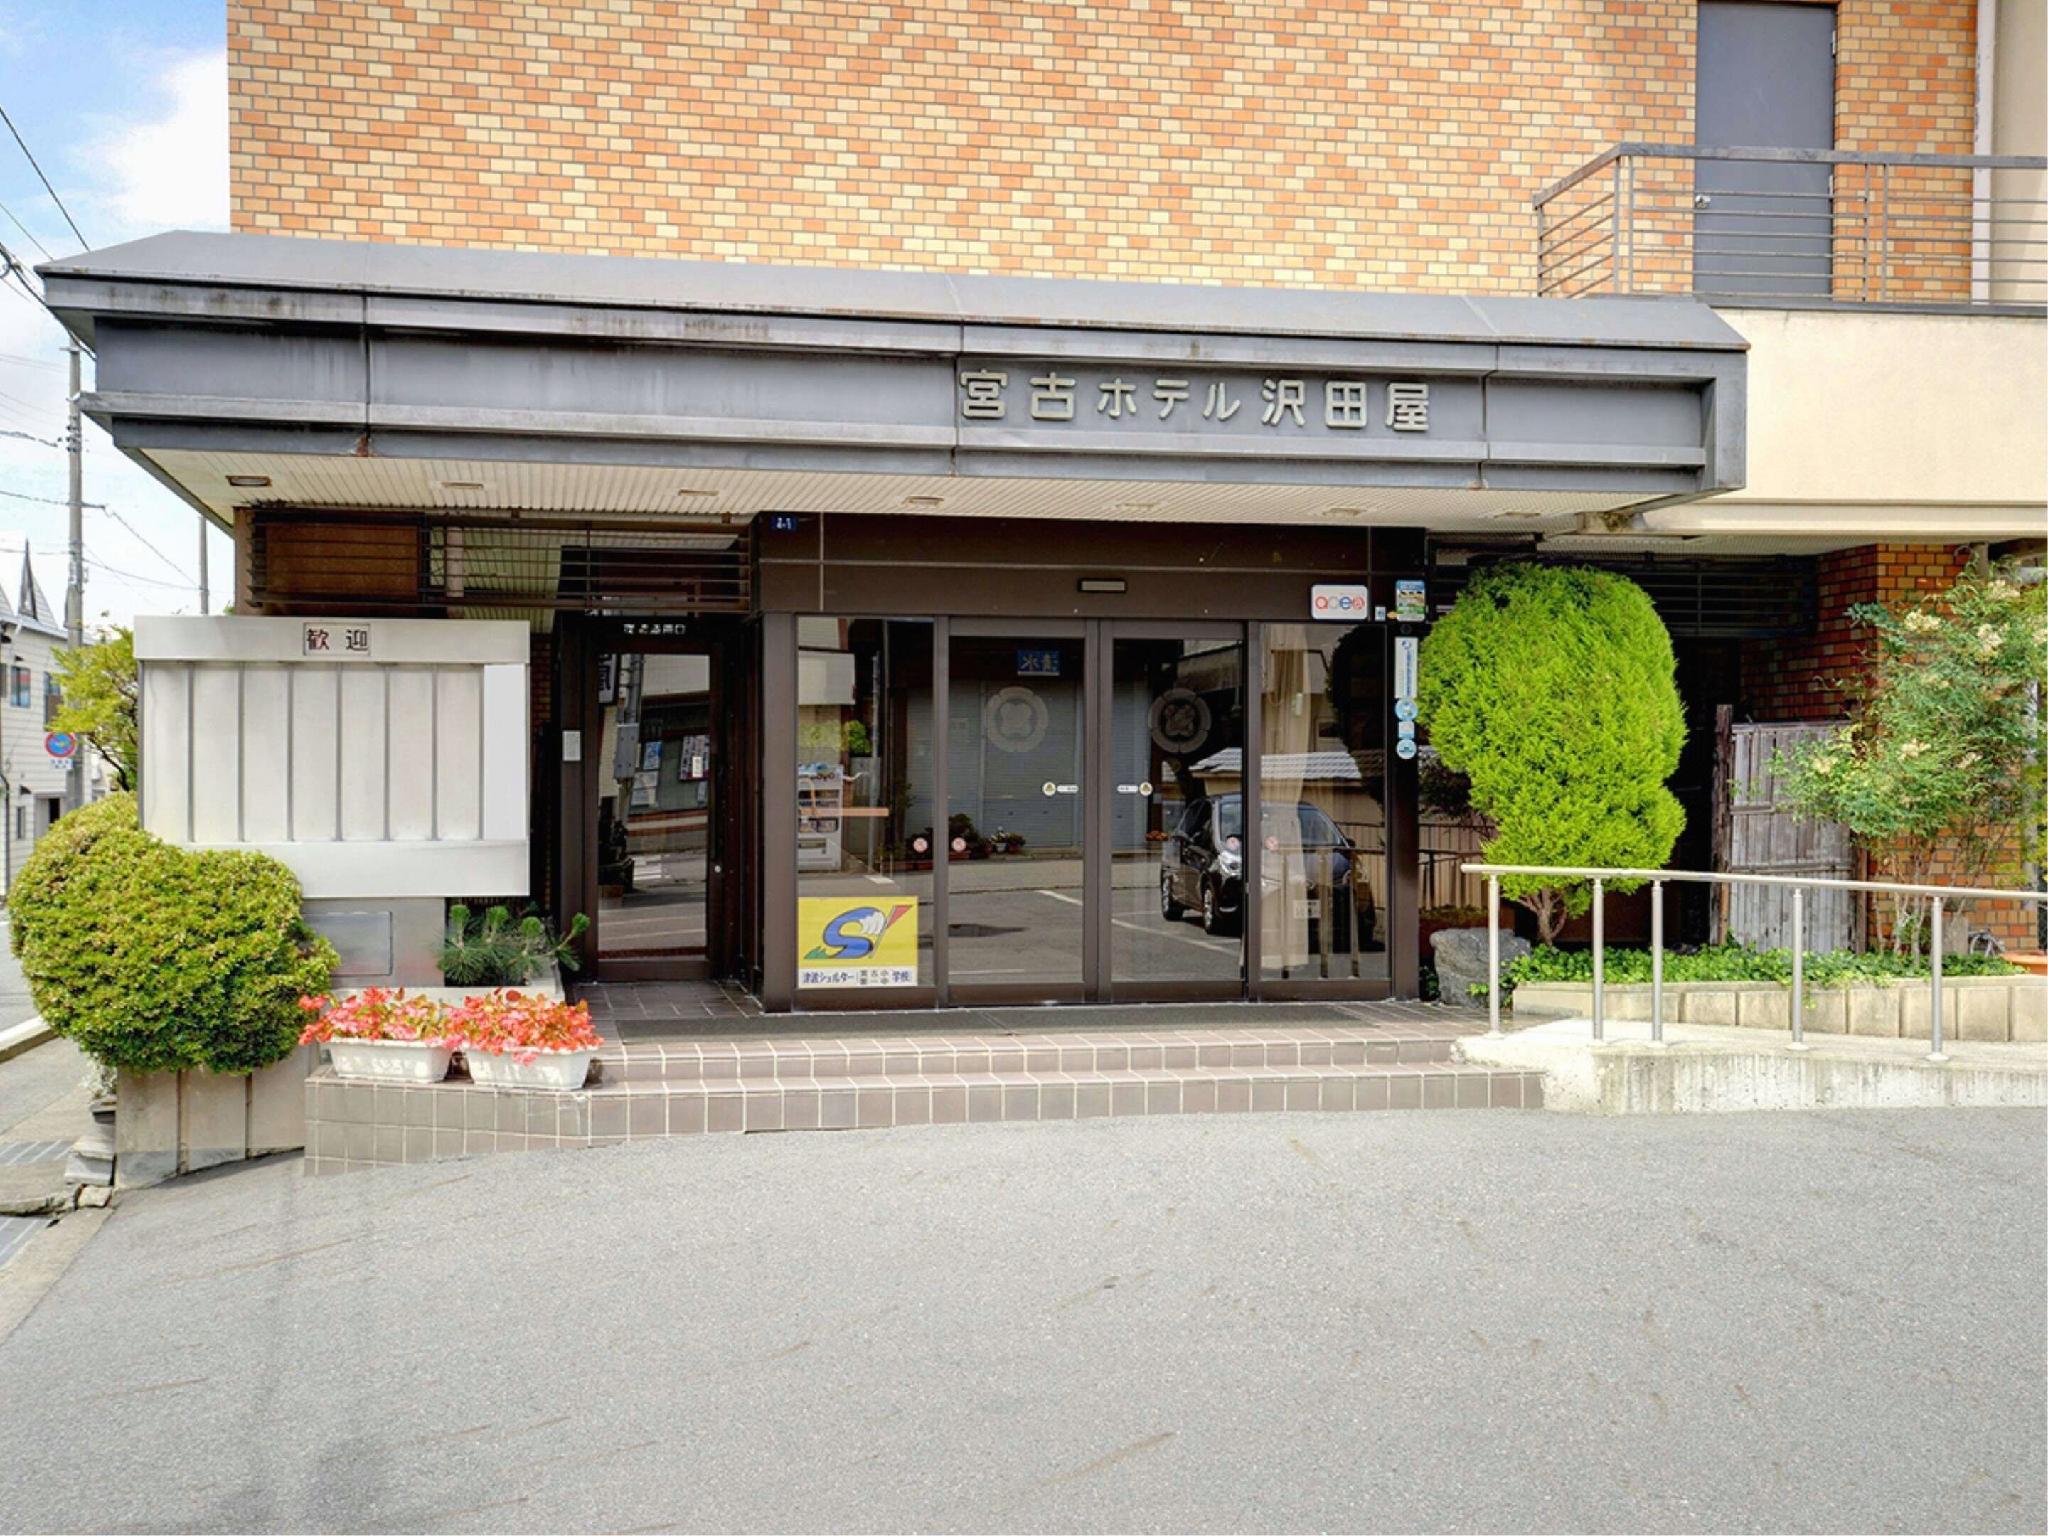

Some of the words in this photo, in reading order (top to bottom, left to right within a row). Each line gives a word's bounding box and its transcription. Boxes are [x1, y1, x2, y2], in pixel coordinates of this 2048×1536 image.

[959, 369, 1431, 432] 宮古ホテル沢田屋
[306, 628, 369, 652] 歓迎
